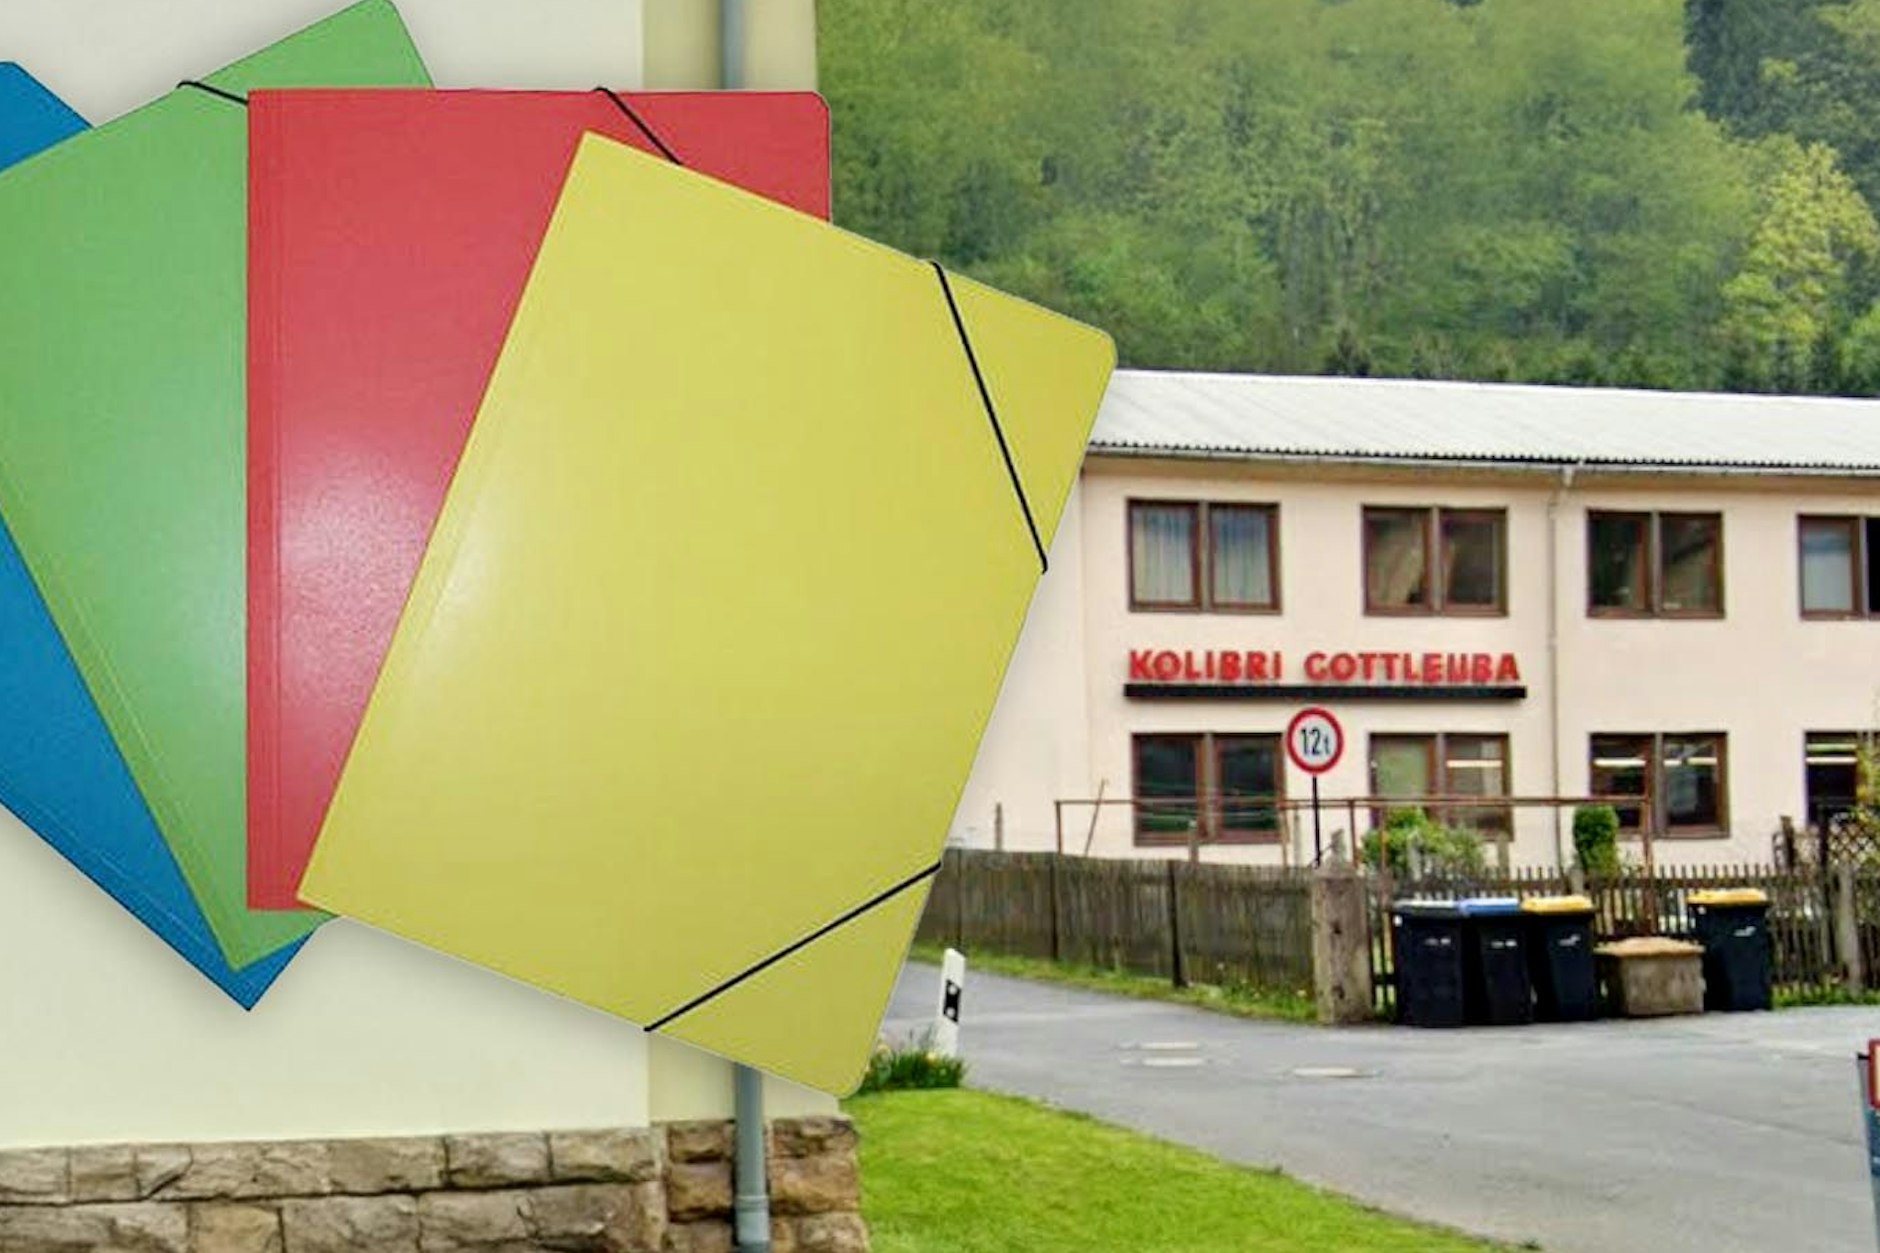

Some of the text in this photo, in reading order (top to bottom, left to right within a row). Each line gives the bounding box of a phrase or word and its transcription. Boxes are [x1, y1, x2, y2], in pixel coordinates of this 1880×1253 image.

[1129, 650, 1520, 683] KOLIBRI GOTTLEUBA
[1301, 726, 1330, 755] 12t
